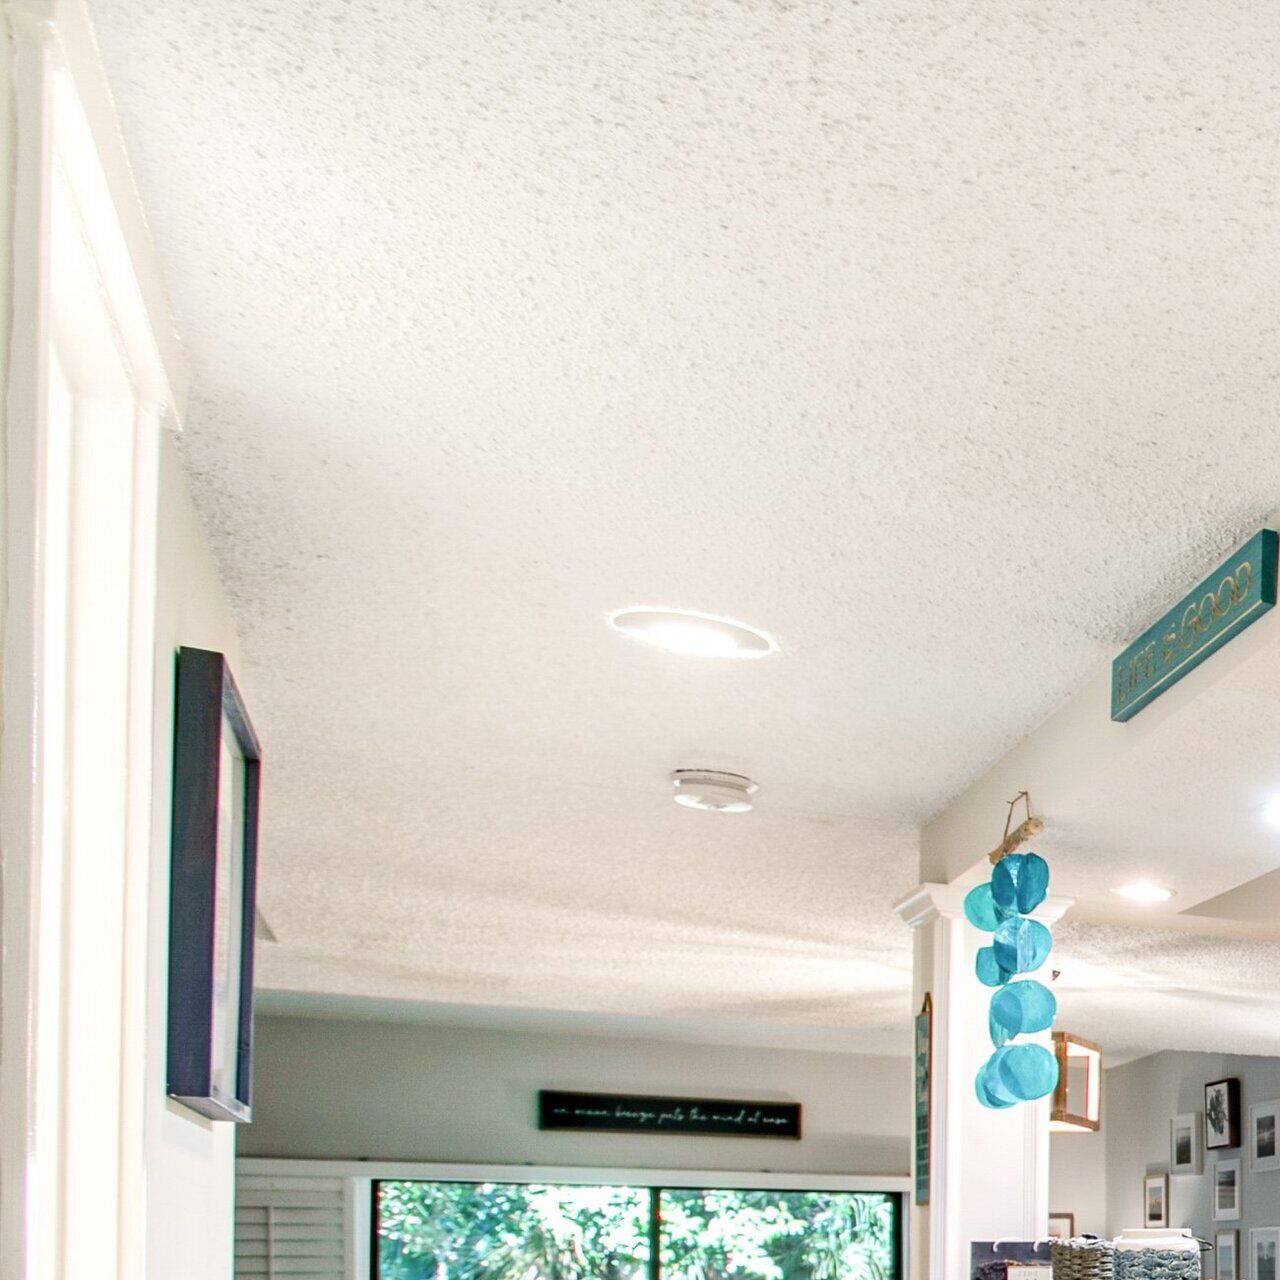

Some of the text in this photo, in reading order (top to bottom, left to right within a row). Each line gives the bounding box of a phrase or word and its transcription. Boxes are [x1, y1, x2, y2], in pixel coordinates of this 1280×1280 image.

[1117, 641, 1157, 704] LIFE
[1180, 561, 1252, 649] GOOD
[657, 1106, 684, 1125] puts
[689, 1106, 708, 1121] the
[711, 1108, 746, 1124] mind
